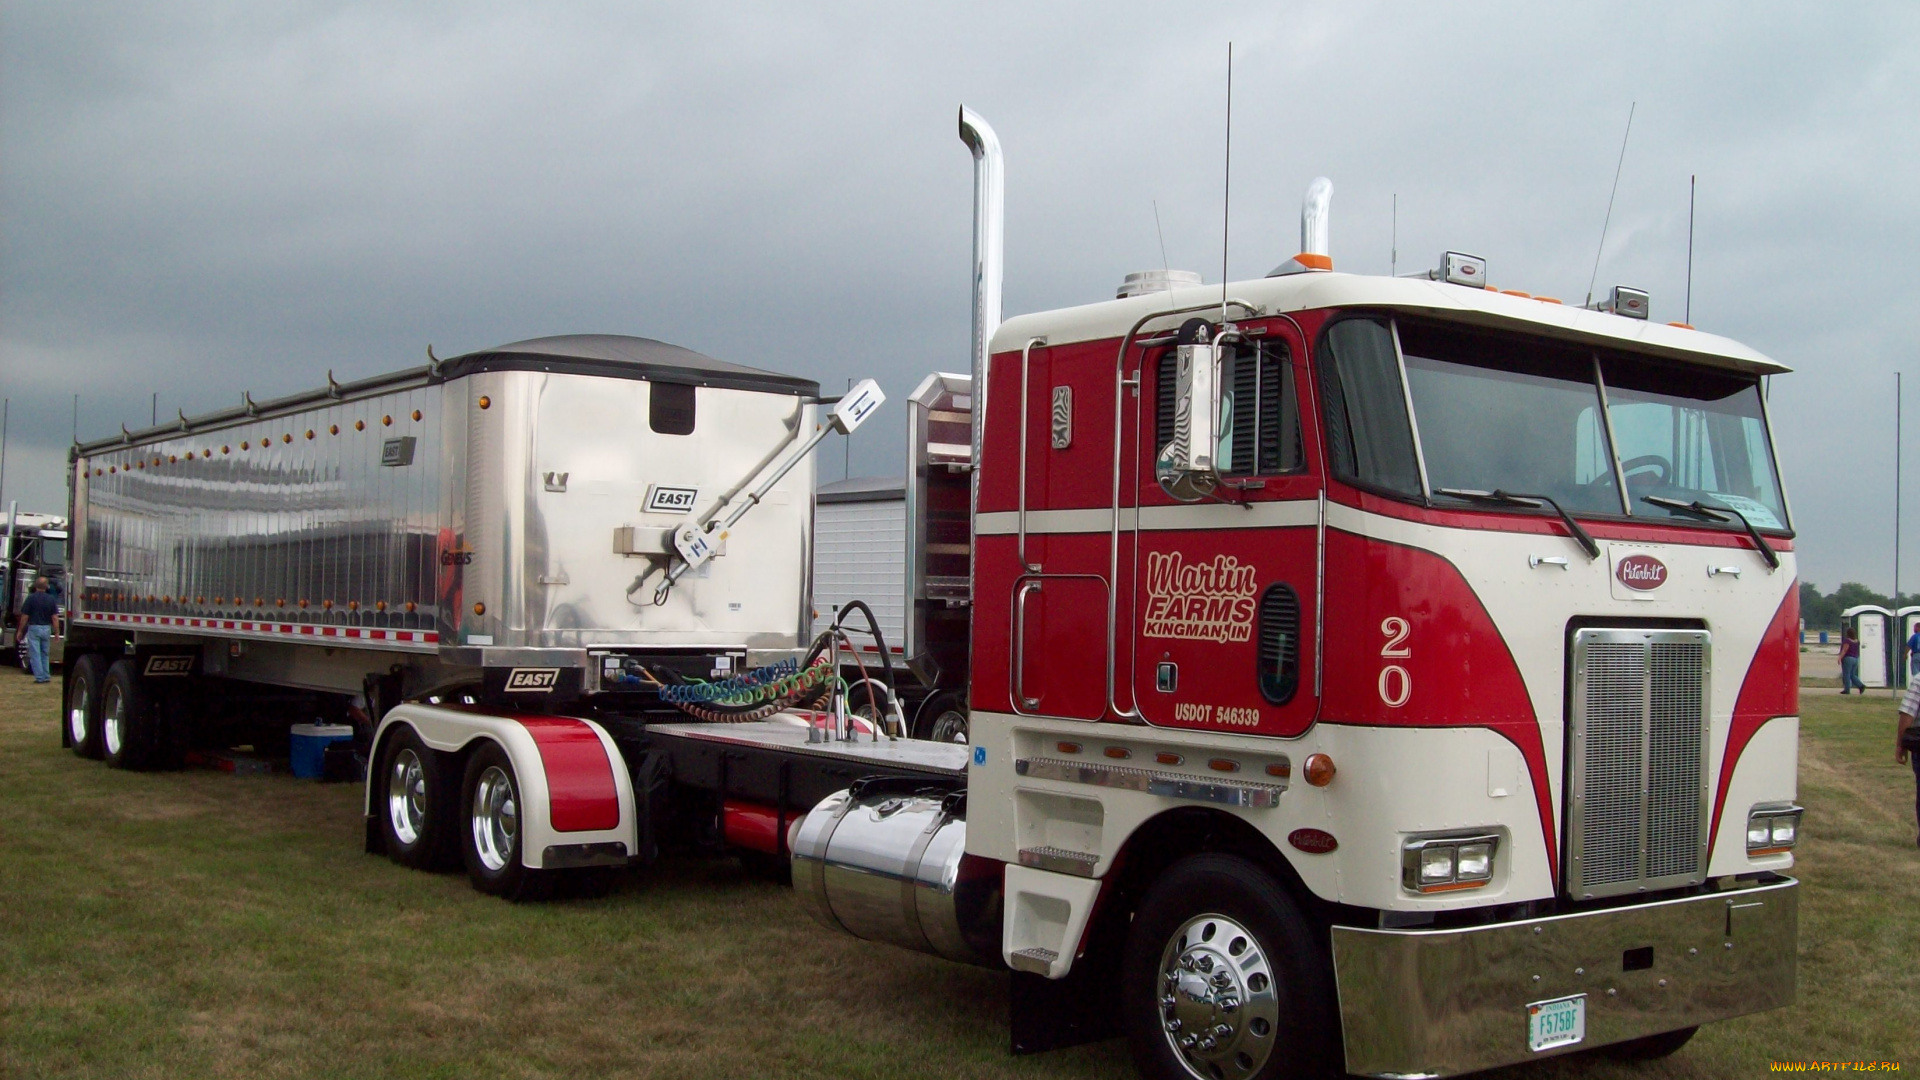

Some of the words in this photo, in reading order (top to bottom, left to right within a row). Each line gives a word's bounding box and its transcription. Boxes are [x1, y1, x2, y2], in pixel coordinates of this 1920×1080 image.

[384, 446, 398, 458] EAST
[657, 493, 691, 505] EAST
[1147, 551, 1257, 596] Martin
[1623, 560, 1664, 581] Peterbilt
[1145, 595, 1256, 624] FARMS
[1144, 621, 1229, 643] KINGMAN,
[1230, 623, 1252, 642] IN
[151, 660, 189, 671] EAST
[512, 673, 553, 686] EAST
[1175, 703, 1212, 722] USDOT
[1216, 706, 1260, 726] 546339
[1292, 832, 1334, 848] Peterbilt
[1545, 1002, 1571, 1012] INDIANA
[1540, 1009, 1578, 1036] F575BF
